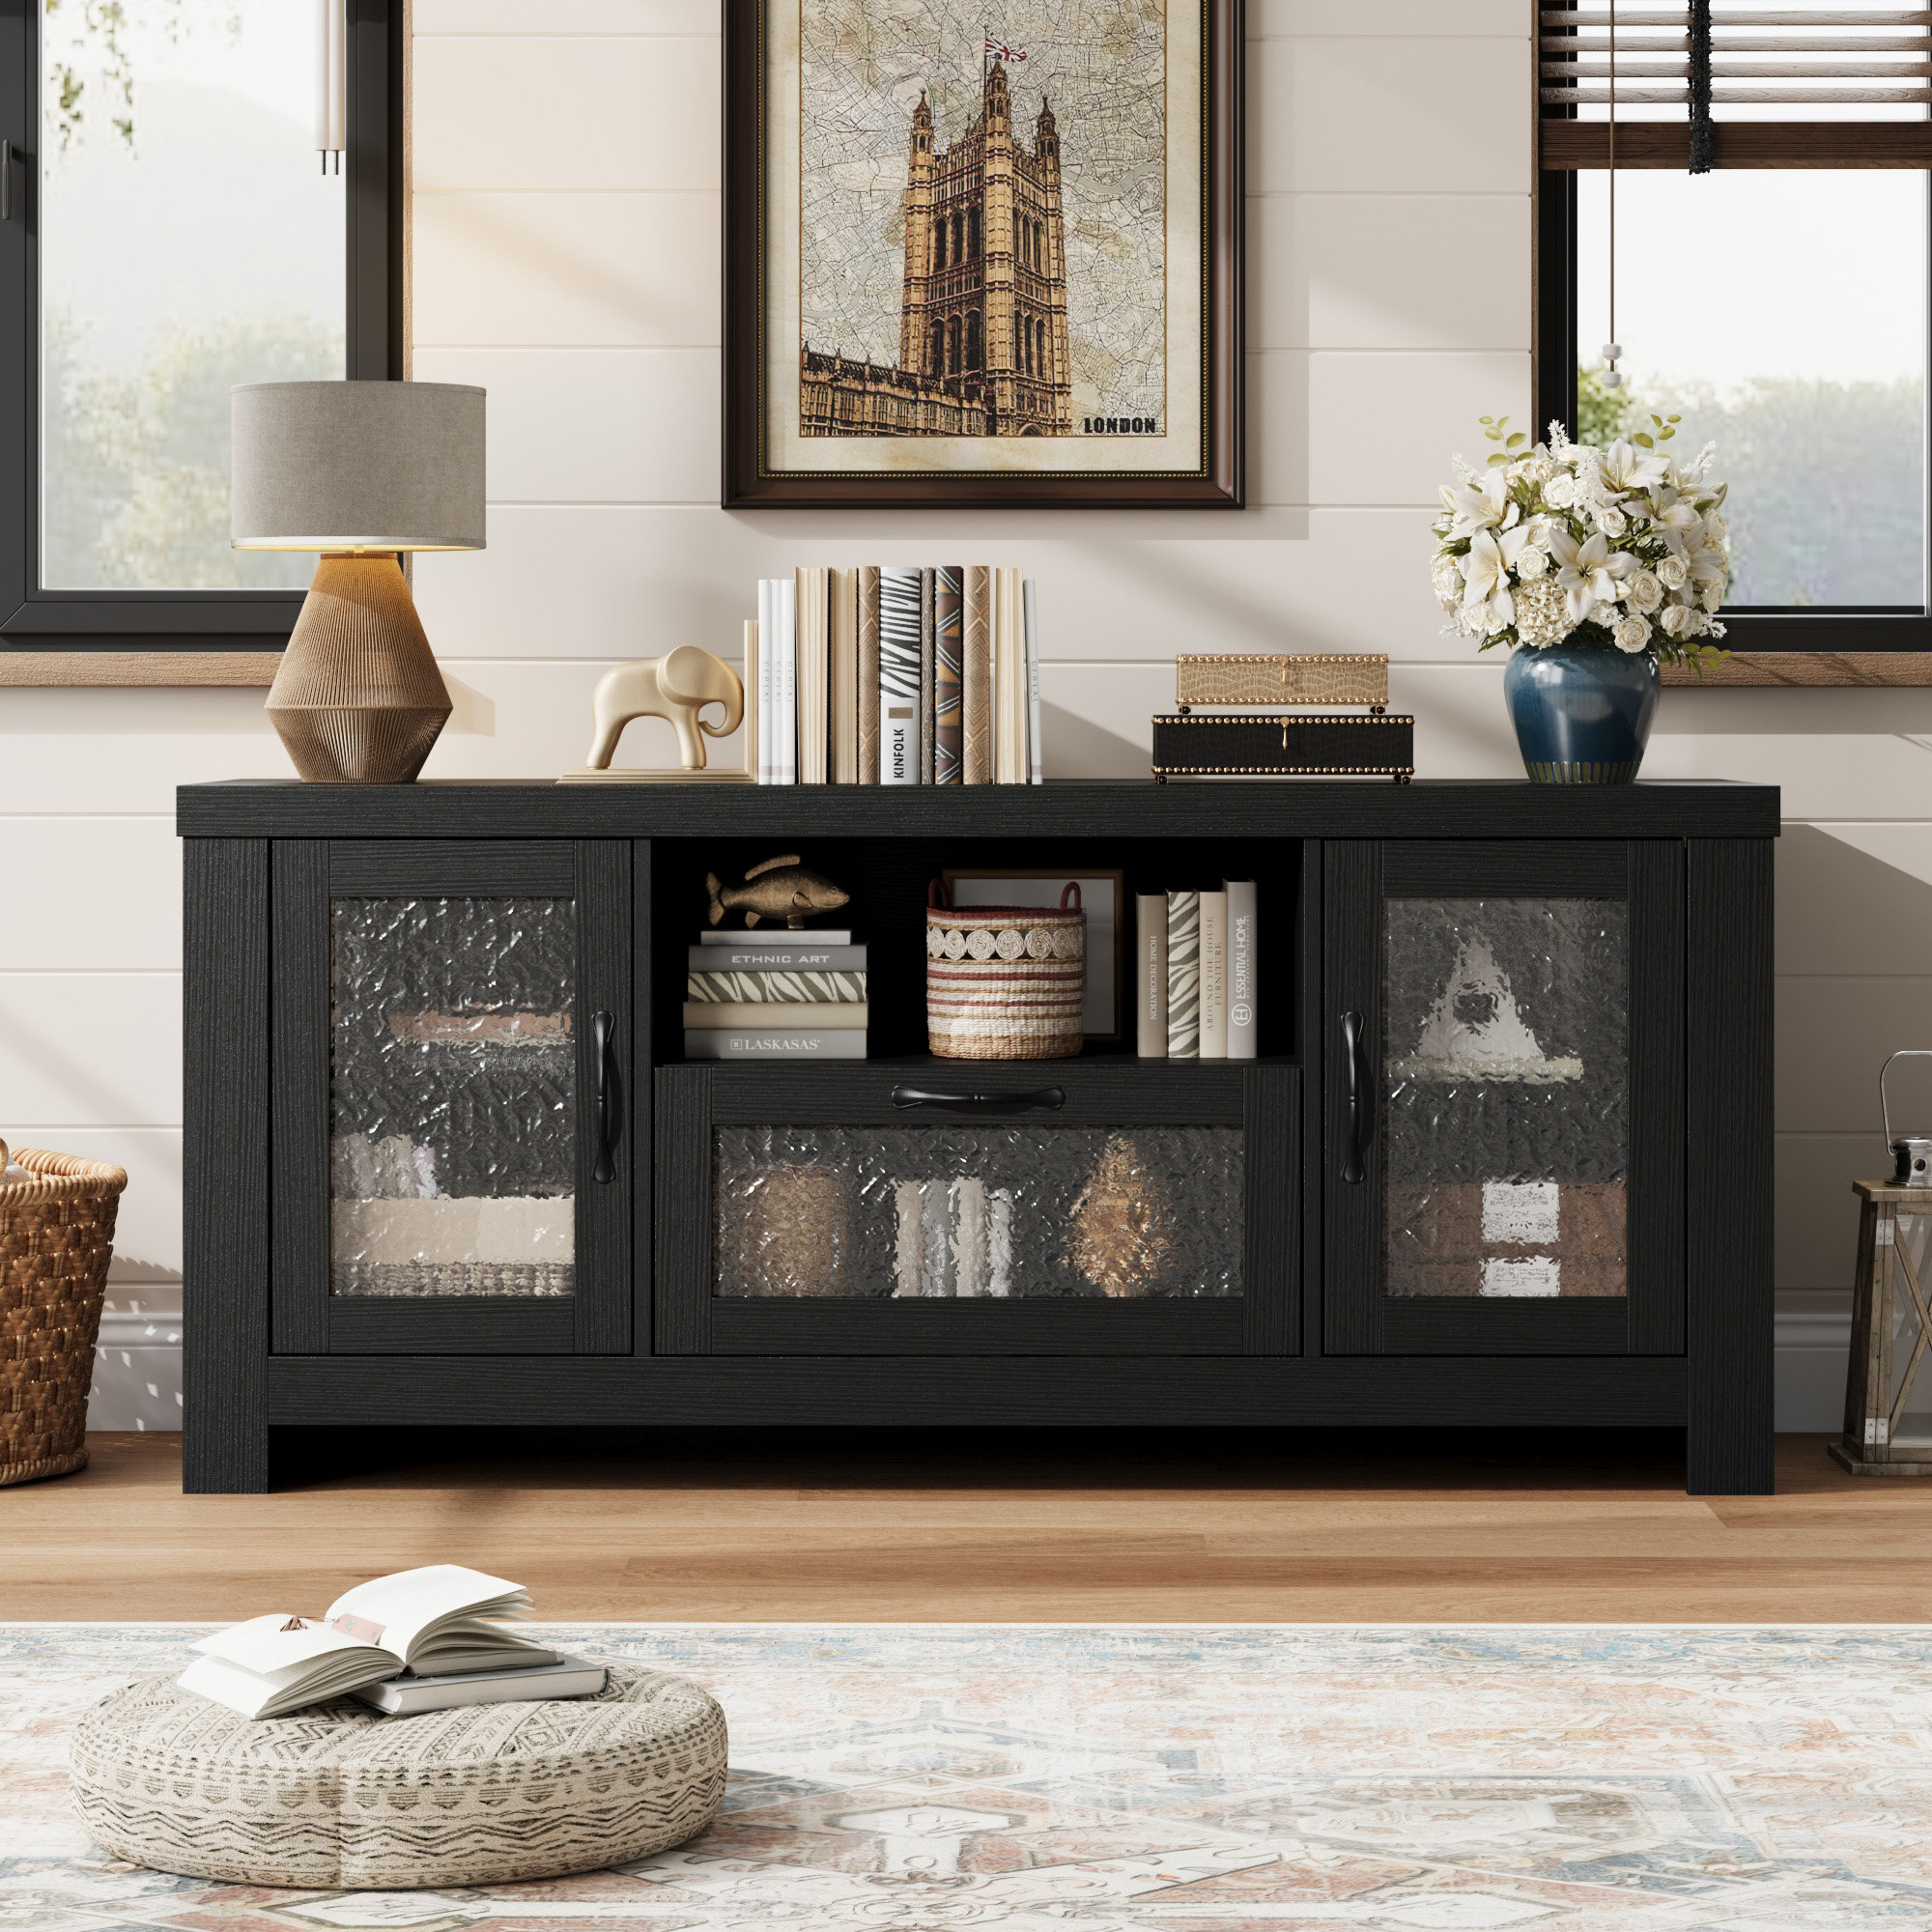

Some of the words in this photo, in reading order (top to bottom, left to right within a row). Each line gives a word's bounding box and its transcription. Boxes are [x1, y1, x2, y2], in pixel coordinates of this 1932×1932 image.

[1084, 416, 1156, 434] LONDON
[894, 728, 904, 779] KINFOLK
[1236, 916, 1246, 949] HOME
[1236, 950, 1246, 999] ESSENTIAL
